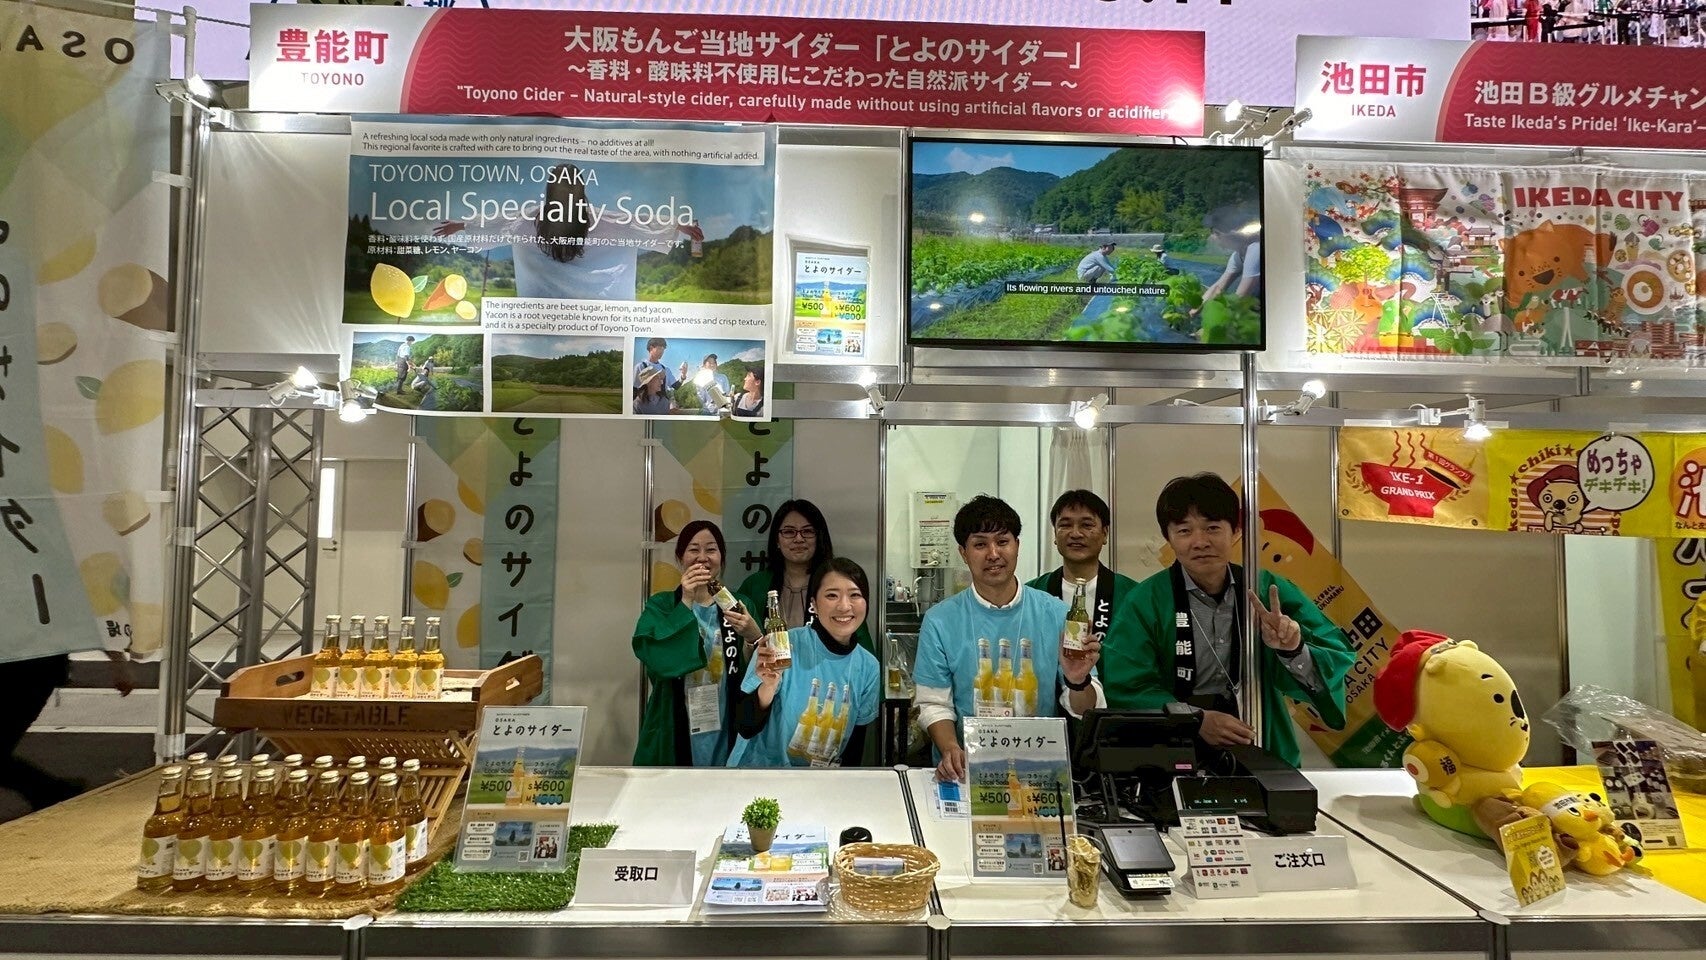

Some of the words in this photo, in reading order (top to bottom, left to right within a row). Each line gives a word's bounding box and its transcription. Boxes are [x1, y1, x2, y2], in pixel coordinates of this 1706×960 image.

[276, 28, 389, 65] 豊能町
[564, 25, 1081, 69] 大阪もんご当地サイダー「とよのサイダー」
[300, 72, 365, 86] TOYONO
[1320, 61, 1427, 97] 池田市
[523, 87, 565, 101] Cider
[584, 89, 686, 107] Natural-style
[690, 92, 733, 108] cider,
[738, 94, 806, 111] carefully
[811, 96, 851, 110] made
[857, 97, 914, 112] without
[919, 99, 960, 116] using
[964, 101, 1026, 116] artificial
[1032, 102, 1083, 117] flavors
[1087, 106, 1103, 118] or
[1351, 105, 1396, 118] IKEDA
[1464, 113, 1506, 129] Taste
[1572, 116, 1618, 132] Pride!
[363, 132, 369, 140] A
[370, 132, 409, 142] refreshing
[471, 134, 489, 142] with
[490, 135, 506, 143] only
[535, 135, 579, 145] ingredients
[600, 139, 633, 147] additives
[635, 139, 642, 147] at
[362, 142, 379, 150] This
[380, 143, 411, 152] regional
[412, 143, 441, 151] favorite
[442, 143, 448, 151] is
[449, 143, 476, 152] crafted
[477, 144, 494, 152] with
[522, 144, 542, 153] bring
[544, 145, 557, 153] out
[574, 147, 589, 155] real
[590, 148, 609, 156] taste
[671, 150, 701, 160] nothing
[702, 151, 733, 160] artificial
[734, 152, 760, 160] added.
[369, 164, 454, 183] TOYONO
[459, 164, 525, 185] TOWN,
[530, 165, 599, 186] OSAKA
[1514, 186, 1613, 208] IKEDA
[1616, 189, 1685, 212] CITY
[371, 191, 450, 221] Local
[461, 191, 607, 231] Specialty
[615, 196, 694, 227] Soda
[804, 265, 861, 275] とよのサイダー
[1006, 283, 1017, 292] Its
[1019, 283, 1048, 293] flowing
[1050, 284, 1073, 293] rivers
[1076, 285, 1091, 293] and
[1093, 286, 1137, 294] untouched
[1139, 287, 1168, 295] nature.
[486, 301, 499, 309] The
[501, 301, 544, 310] ingredients
[560, 303, 578, 311] beet
[579, 304, 603, 313] sugar,
[604, 304, 630, 313] lemon,
[632, 305, 648, 313] and
[485, 311, 508, 319] Yacon
[541, 312, 581, 322] vegetable
[582, 313, 609, 321] known
[633, 315, 661, 323] natural
[662, 316, 701, 324] sweetness
[702, 317, 717, 325] and
[719, 318, 737, 327] crisp
[738, 319, 767, 327] texture,
[485, 321, 500, 329] and
[501, 321, 506, 329] it
[508, 321, 514, 329] is
[521, 322, 555, 332] specialty
[557, 323, 589, 332] product
[590, 323, 599, 331] of
[600, 324, 629, 333] Toyono
[1517, 444, 1562, 473] chiki
[1587, 448, 1642, 475] めっちゃ
[1389, 470, 1424, 485] IKE-1
[1380, 485, 1415, 499] GRAND
[1414, 489, 1436, 501] PRIX
[1175, 611, 1193, 681] 豊能町
[1354, 637, 1390, 674] CITY
[1346, 673, 1376, 704] OSAKA
[283, 705, 410, 726] VEGETABLE
[493, 724, 572, 736] とよのサイダー
[979, 736, 1057, 748] とよのサイダー
[480, 780, 512, 792] ¥500
[533, 780, 565, 792] ¥600
[980, 792, 1011, 804] ¥500
[1274, 852, 1326, 868] ご注文口
[614, 865, 659, 882] 受取口
